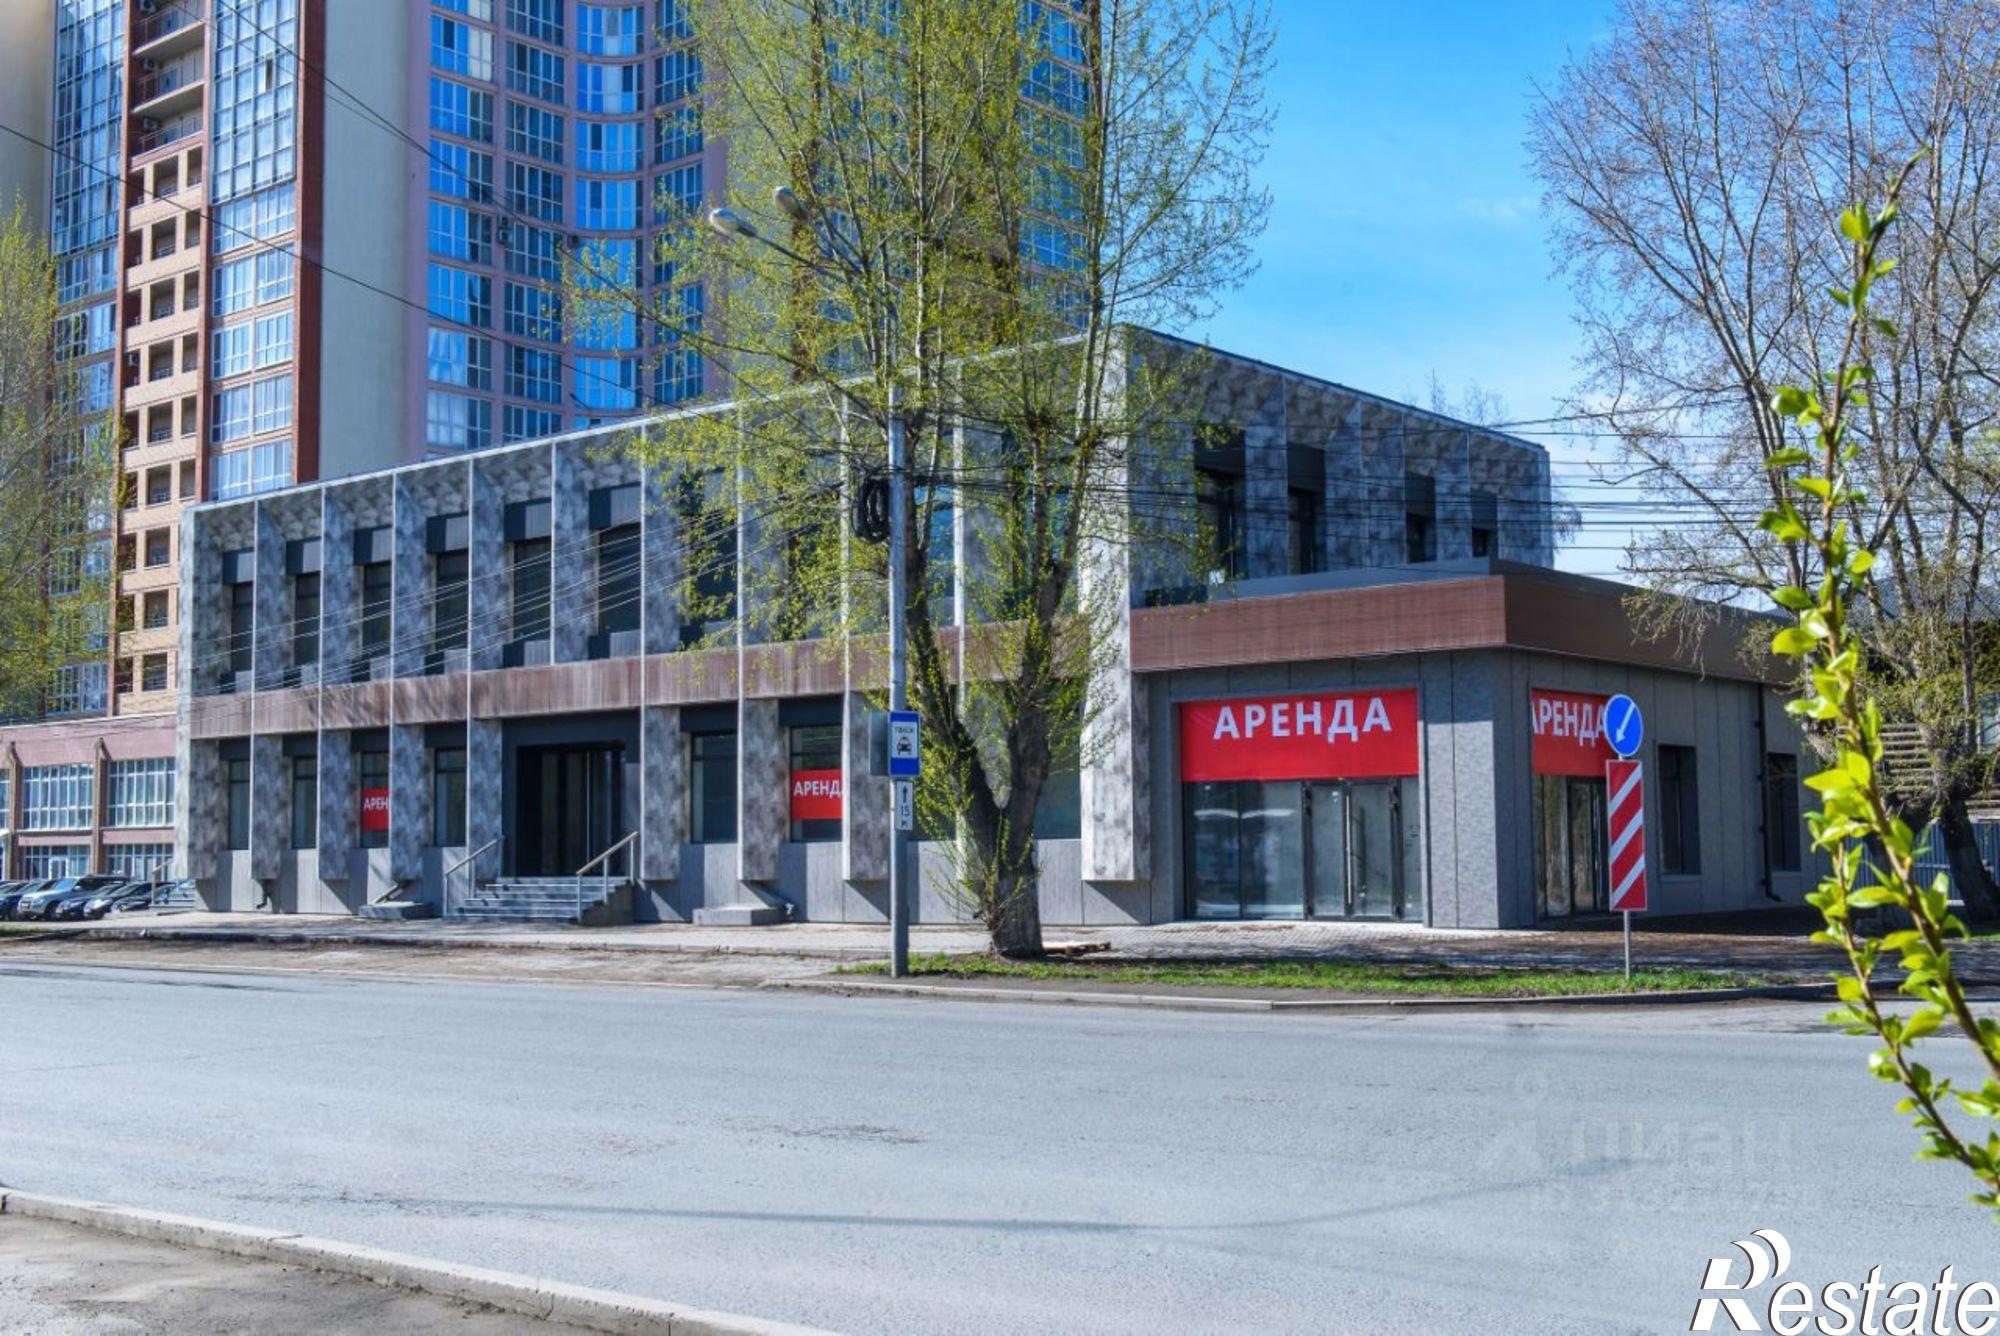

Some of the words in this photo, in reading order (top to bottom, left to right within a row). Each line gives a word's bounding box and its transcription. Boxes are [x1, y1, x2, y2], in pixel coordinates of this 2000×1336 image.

[1213, 697, 1392, 743] АРЕНДА
[793, 780, 842, 799] АРЕНД
[901, 805, 910, 816] 15
